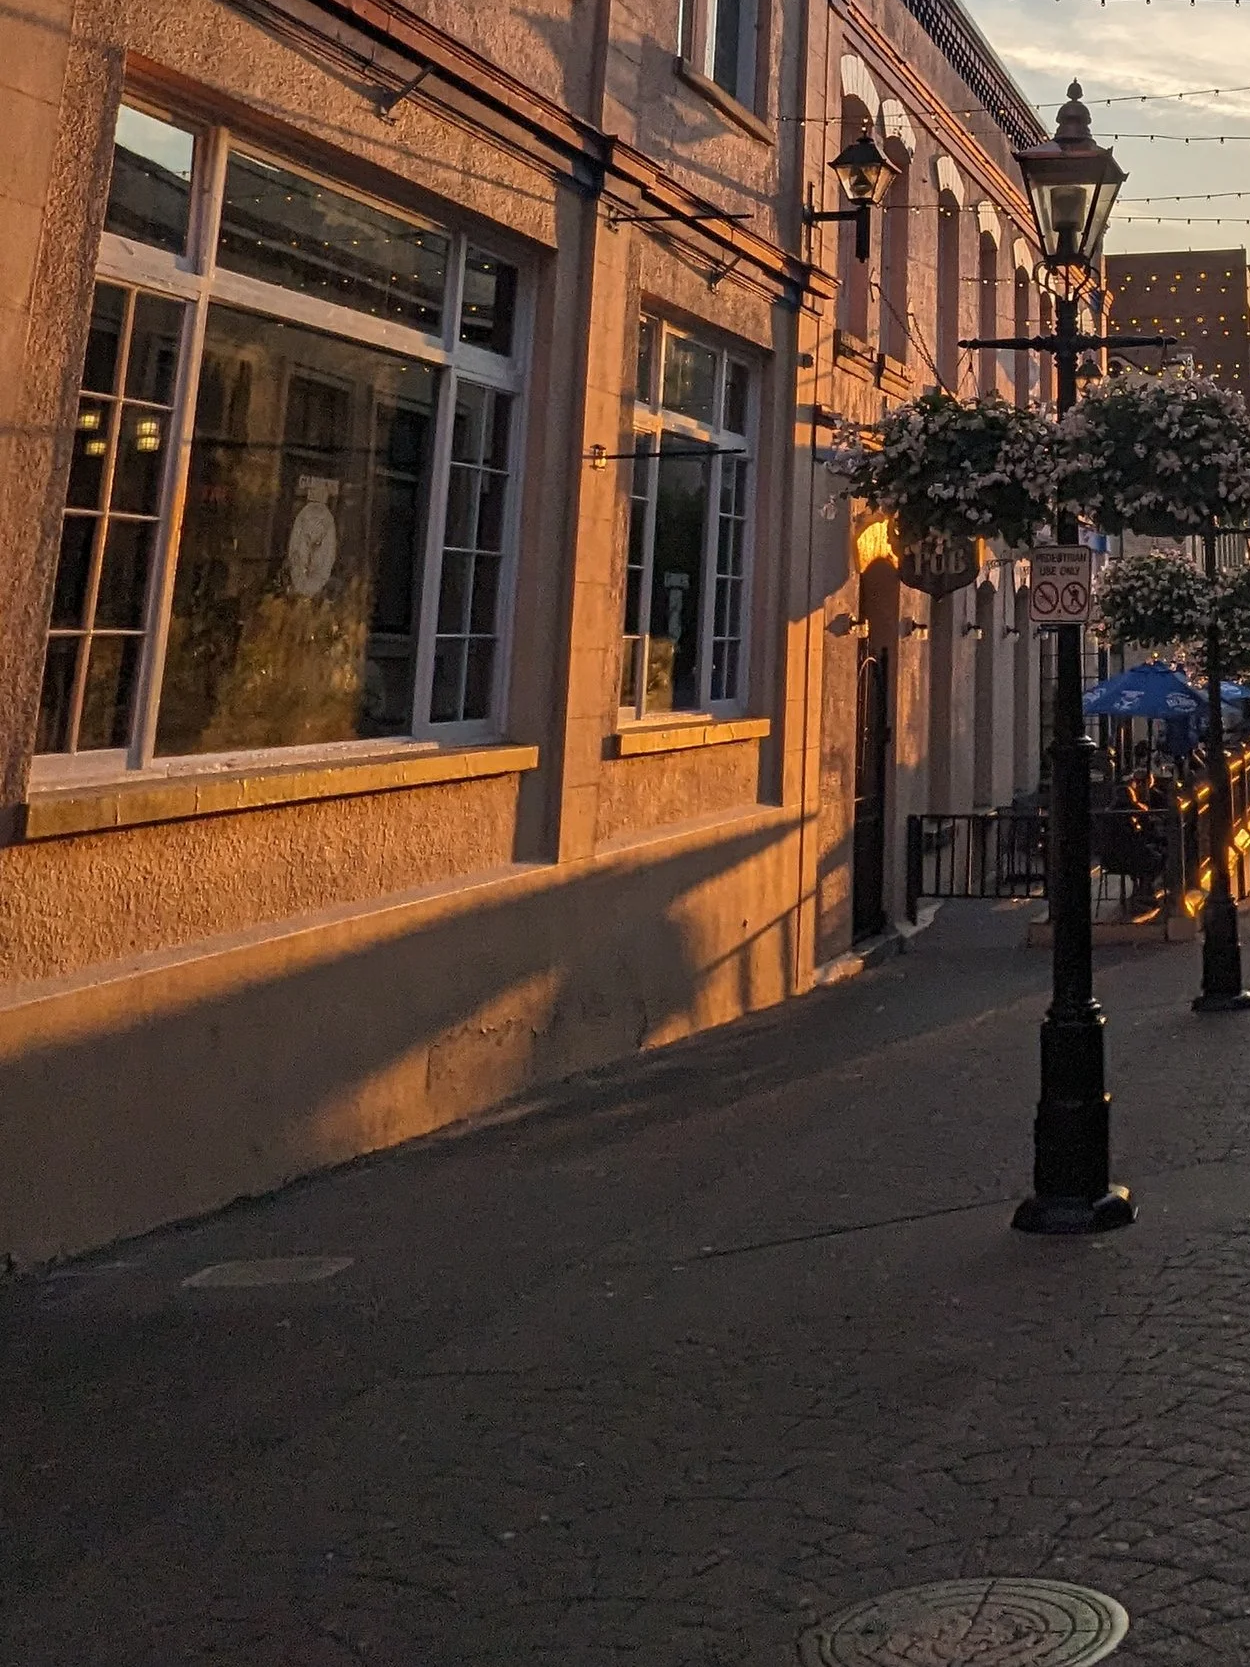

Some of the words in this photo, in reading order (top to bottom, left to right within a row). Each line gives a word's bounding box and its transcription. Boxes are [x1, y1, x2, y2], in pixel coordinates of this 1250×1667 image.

[1036, 553, 1087, 563] PEDESTRIAN
[1039, 566, 1057, 576] USE
[1059, 566, 1081, 576] ONLY
